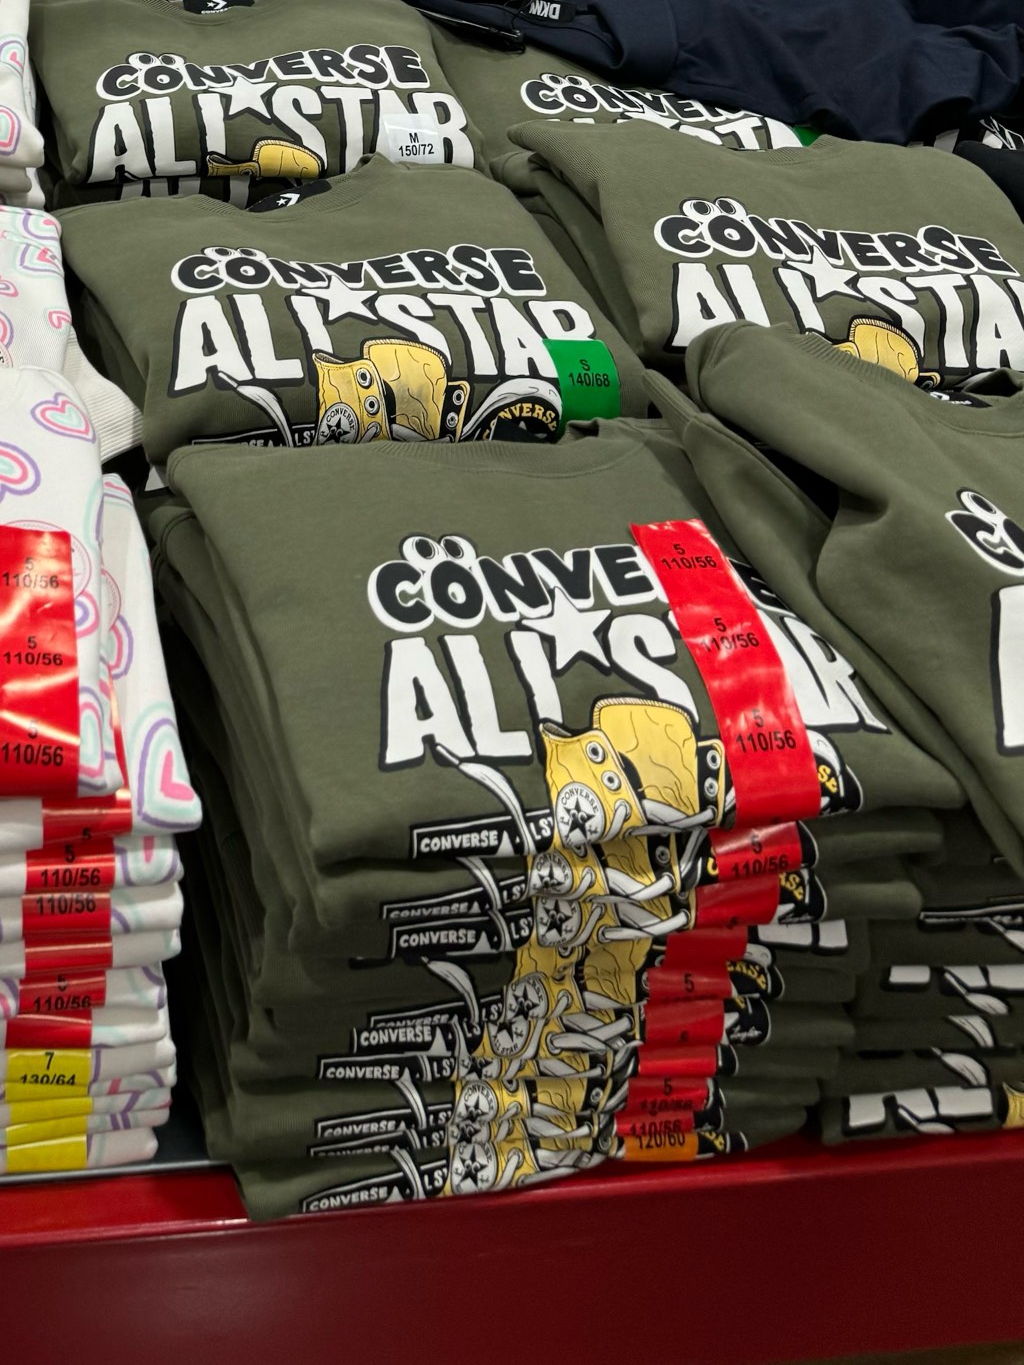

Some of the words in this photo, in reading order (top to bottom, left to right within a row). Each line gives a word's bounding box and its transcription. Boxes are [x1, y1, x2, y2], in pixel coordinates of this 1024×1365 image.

[97, 43, 430, 101] CONVERSE
[408, 132, 419, 144] M
[397, 142, 435, 158] 150/72
[654, 197, 1021, 276] CONVERSE
[171, 244, 547, 296] CONVERSE
[856, 272, 1024, 371] STA
[580, 357, 591, 372] S
[567, 371, 612, 389] 140/68
[675, 543, 685, 556] 5
[25, 556, 35, 570] 5
[661, 553, 718, 572] 110/56
[1, 571, 60, 589] 110/56
[715, 617, 727, 632] 5
[27, 635, 38, 649] 5
[700, 631, 760, 654] 110/56
[2, 651, 64, 666] 110/56
[753, 709, 764, 728] 5
[736, 729, 798, 755] 110/56
[0, 743, 65, 767] 110/56
[420, 828, 500, 853] CONVERSE
[752, 835, 762, 854] 5
[64, 843, 76, 863] 5
[731, 855, 790, 879] 110/56
[41, 868, 102, 888] 110/56
[35, 892, 97, 916] 110/56
[399, 930, 477, 949] CONVERSE
[683, 974, 695, 992] 5
[360, 1026, 433, 1046] CONVERSE
[45, 1051, 56, 1071] 7
[326, 1065, 401, 1081] CONVERSE
[663, 1077, 673, 1096] 5
[324, 1120, 397, 1138] CONVERSE
[309, 1186, 389, 1213] CONVERSE
